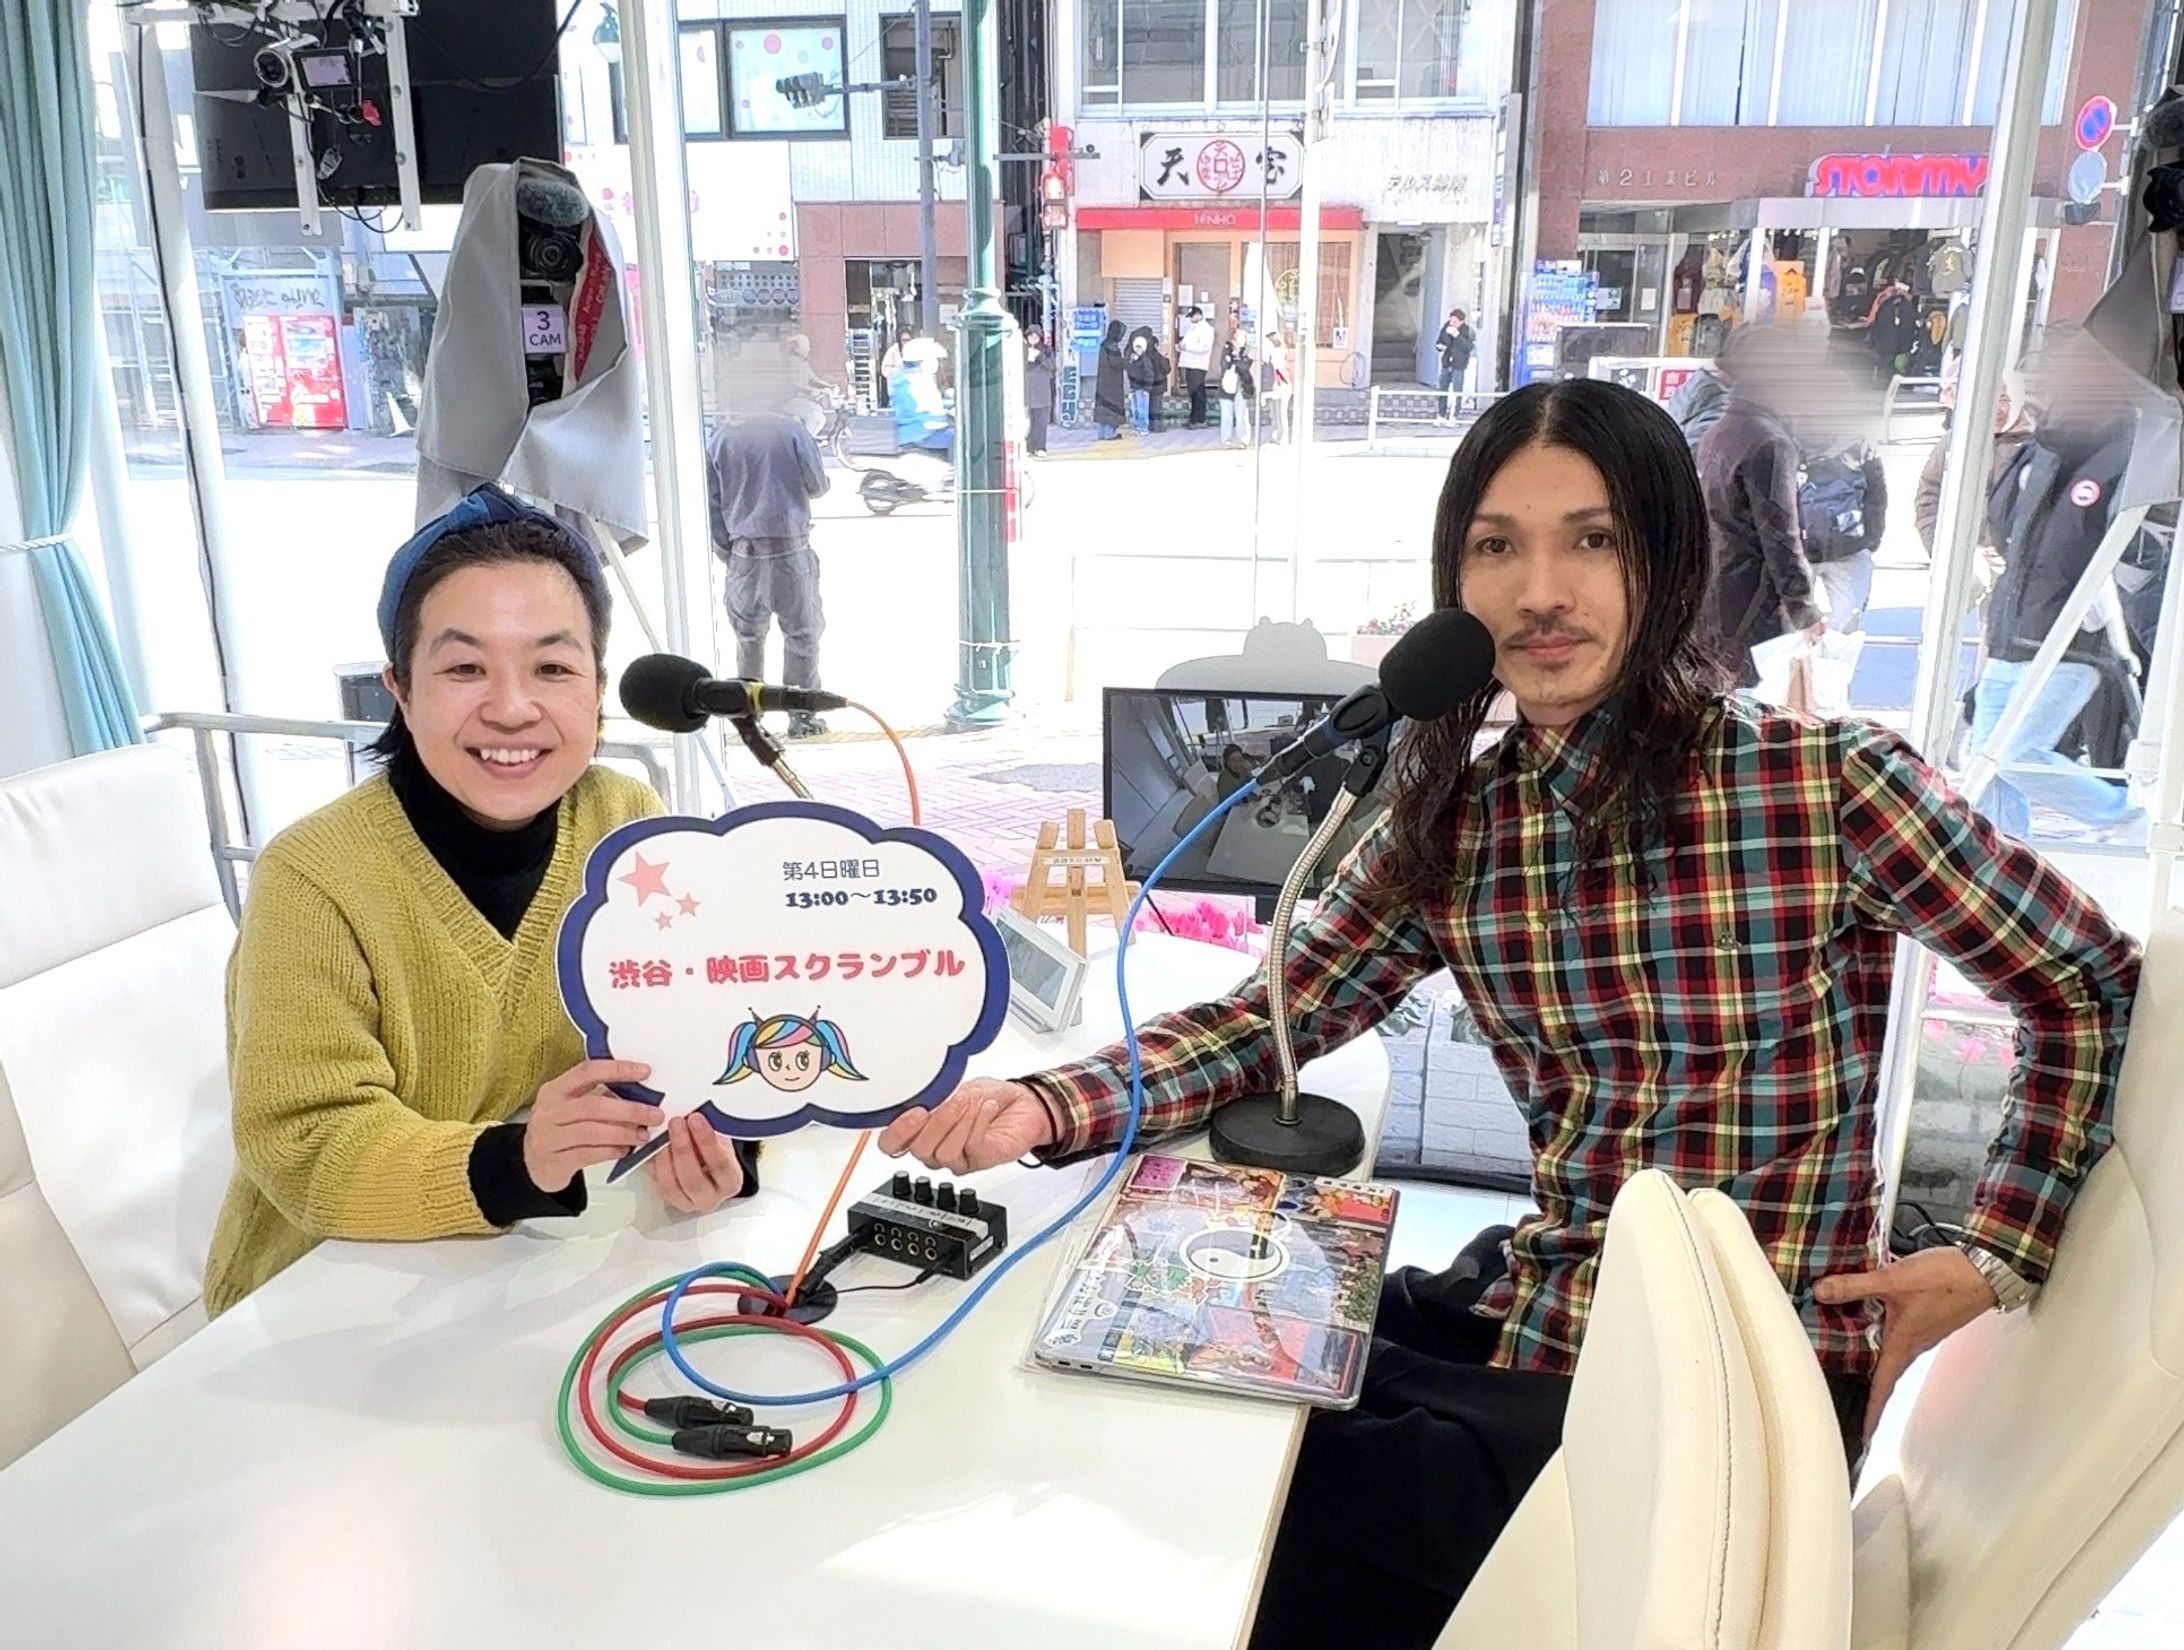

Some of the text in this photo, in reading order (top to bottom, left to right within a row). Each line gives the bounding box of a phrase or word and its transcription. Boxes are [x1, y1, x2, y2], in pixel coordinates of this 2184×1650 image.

[537, 311, 551, 331] 3
[529, 333, 562, 347] CAM
[782, 859, 881, 881] 第4日曜日
[608, 948, 966, 990] 渋谷・映画スクランブル
